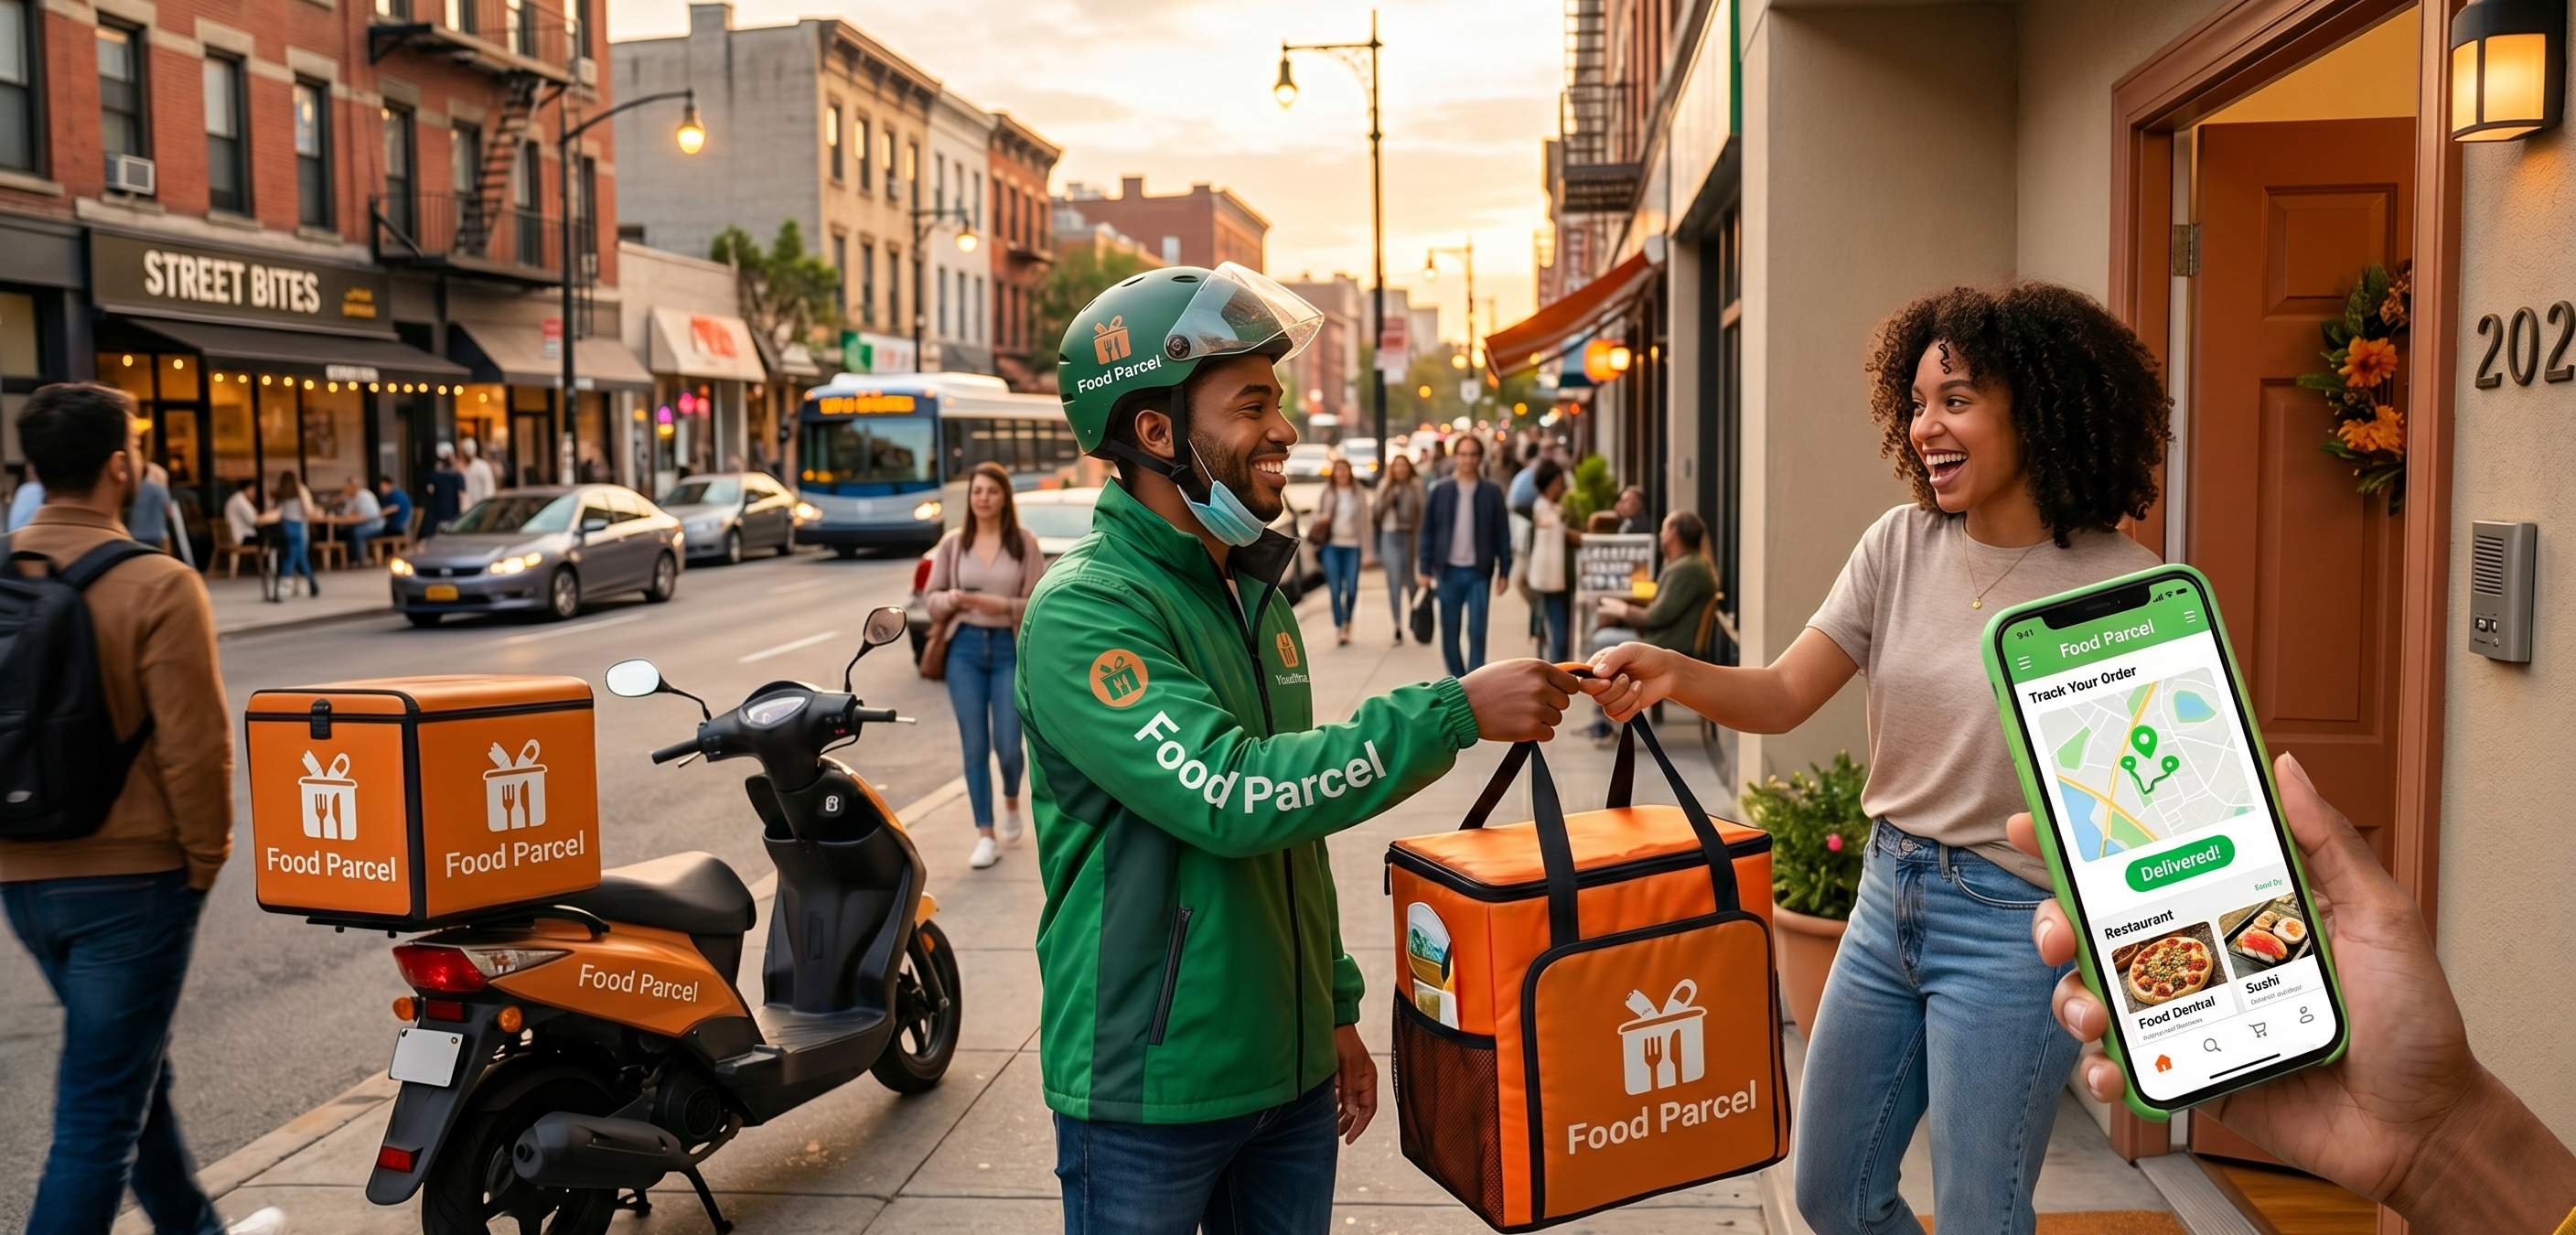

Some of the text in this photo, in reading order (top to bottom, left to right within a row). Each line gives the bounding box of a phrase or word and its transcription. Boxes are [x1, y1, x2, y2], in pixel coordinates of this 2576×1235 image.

[144, 249, 245, 305] STREET
[250, 263, 321, 314] BITES
[2474, 300, 2576, 390] 202
[1077, 354, 1162, 393] Food Parcel
[2059, 618, 2155, 658] Food Parcel
[2028, 667, 2137, 704] Track Your Order
[1133, 710, 1388, 814] Food Parcel
[266, 847, 396, 882] Food Parcel
[445, 830, 585, 878] Food Parcel
[2141, 844, 2221, 882] Delivered!
[2104, 909, 2174, 940] Restaurant
[578, 963, 698, 1003] Food Parcel
[2246, 974, 2280, 994] Sushi
[2138, 1010, 2171, 1030] Food
[2173, 996, 2216, 1018] Dentral
[1568, 1079, 1756, 1154] Food Parcel
